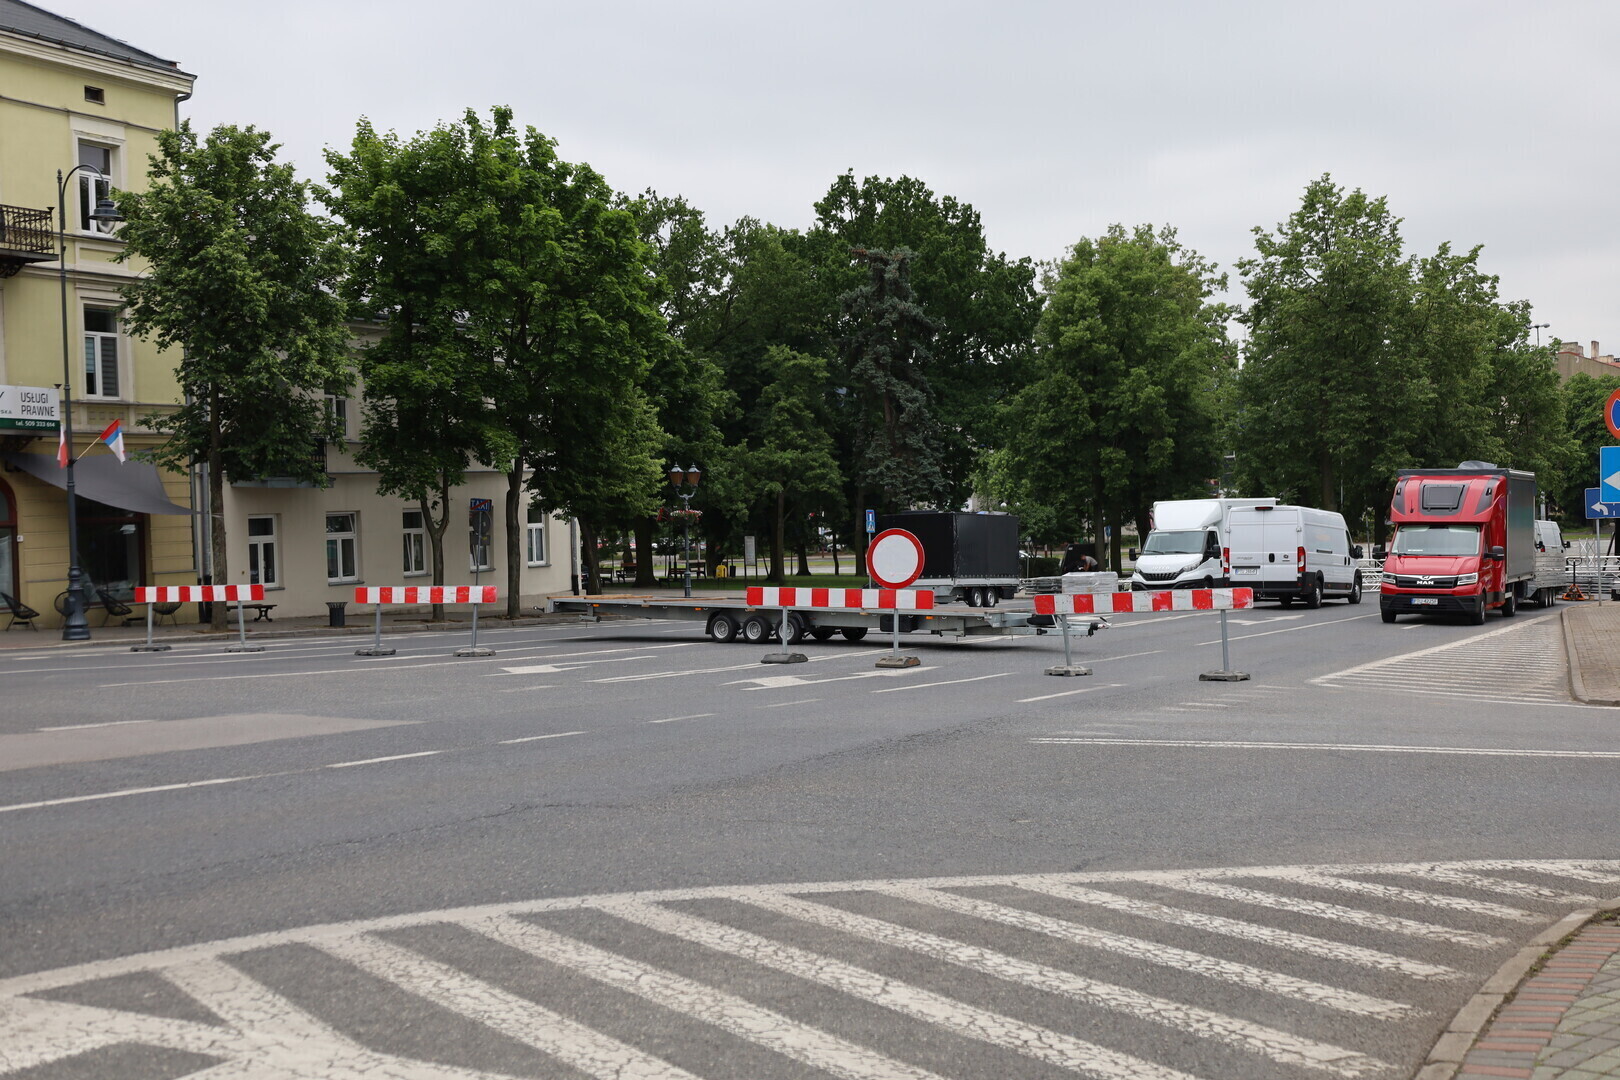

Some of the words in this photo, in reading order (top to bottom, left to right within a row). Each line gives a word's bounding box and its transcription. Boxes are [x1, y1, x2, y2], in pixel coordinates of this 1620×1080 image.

[20, 391, 49, 404] USŁUGI
[21, 404, 55, 417] PRAWNE
[471, 500, 488, 510] TAXI
